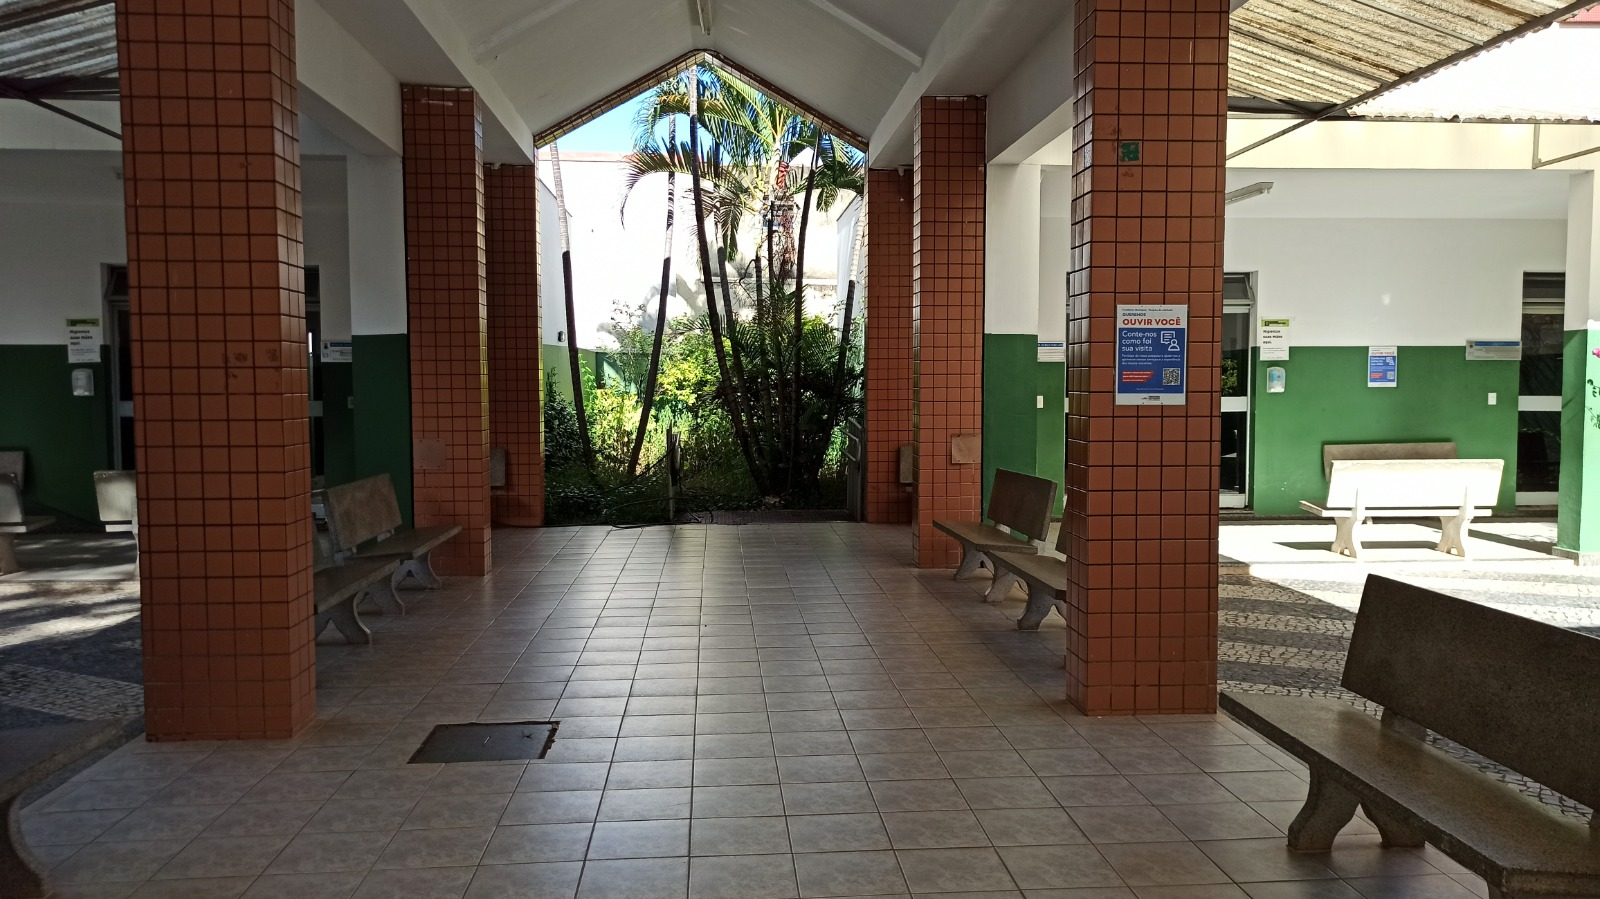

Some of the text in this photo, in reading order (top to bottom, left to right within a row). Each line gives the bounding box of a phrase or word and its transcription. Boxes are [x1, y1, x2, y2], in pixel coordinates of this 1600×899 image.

[1122, 317, 1181, 326] OUVIR VOCÊ
[1122, 330, 1157, 338] Conte-nos
